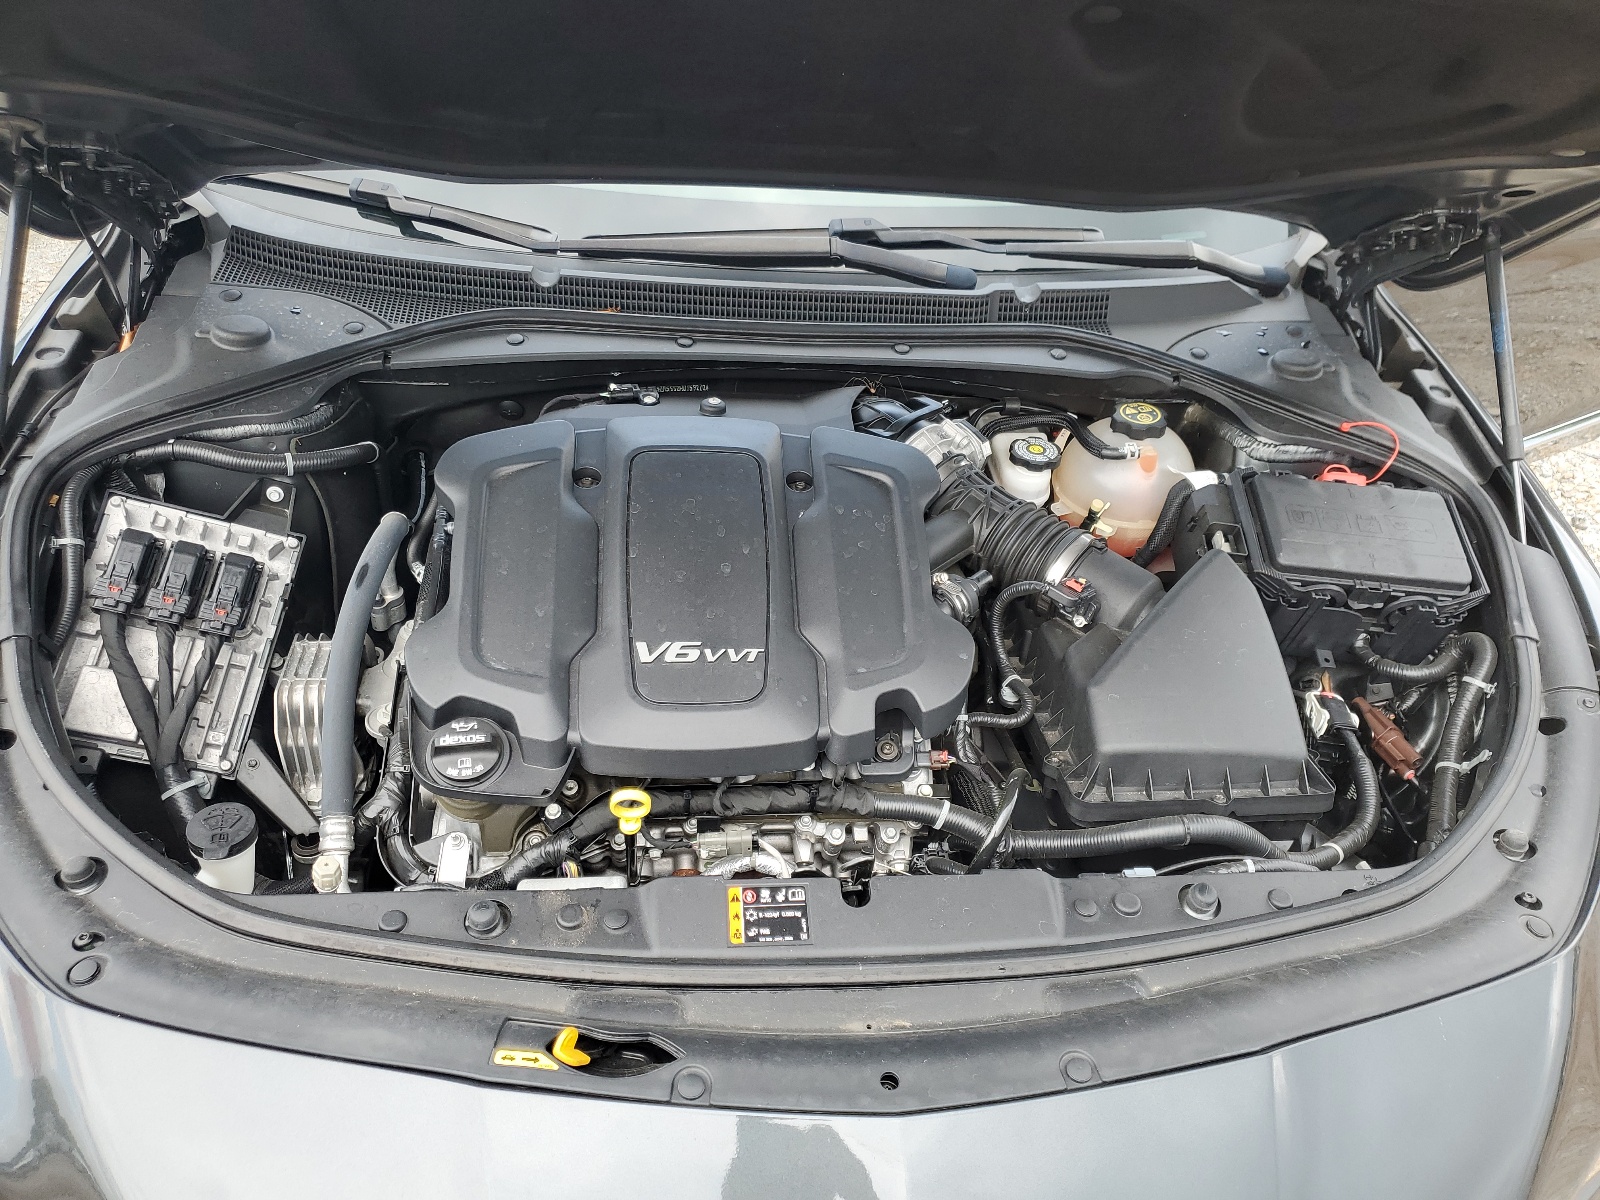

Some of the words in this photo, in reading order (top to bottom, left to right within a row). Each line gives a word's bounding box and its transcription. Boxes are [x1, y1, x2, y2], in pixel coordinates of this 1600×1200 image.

[635, 641, 702, 664] V6
[704, 648, 765, 663] VVT
[440, 734, 487, 746] dexos
